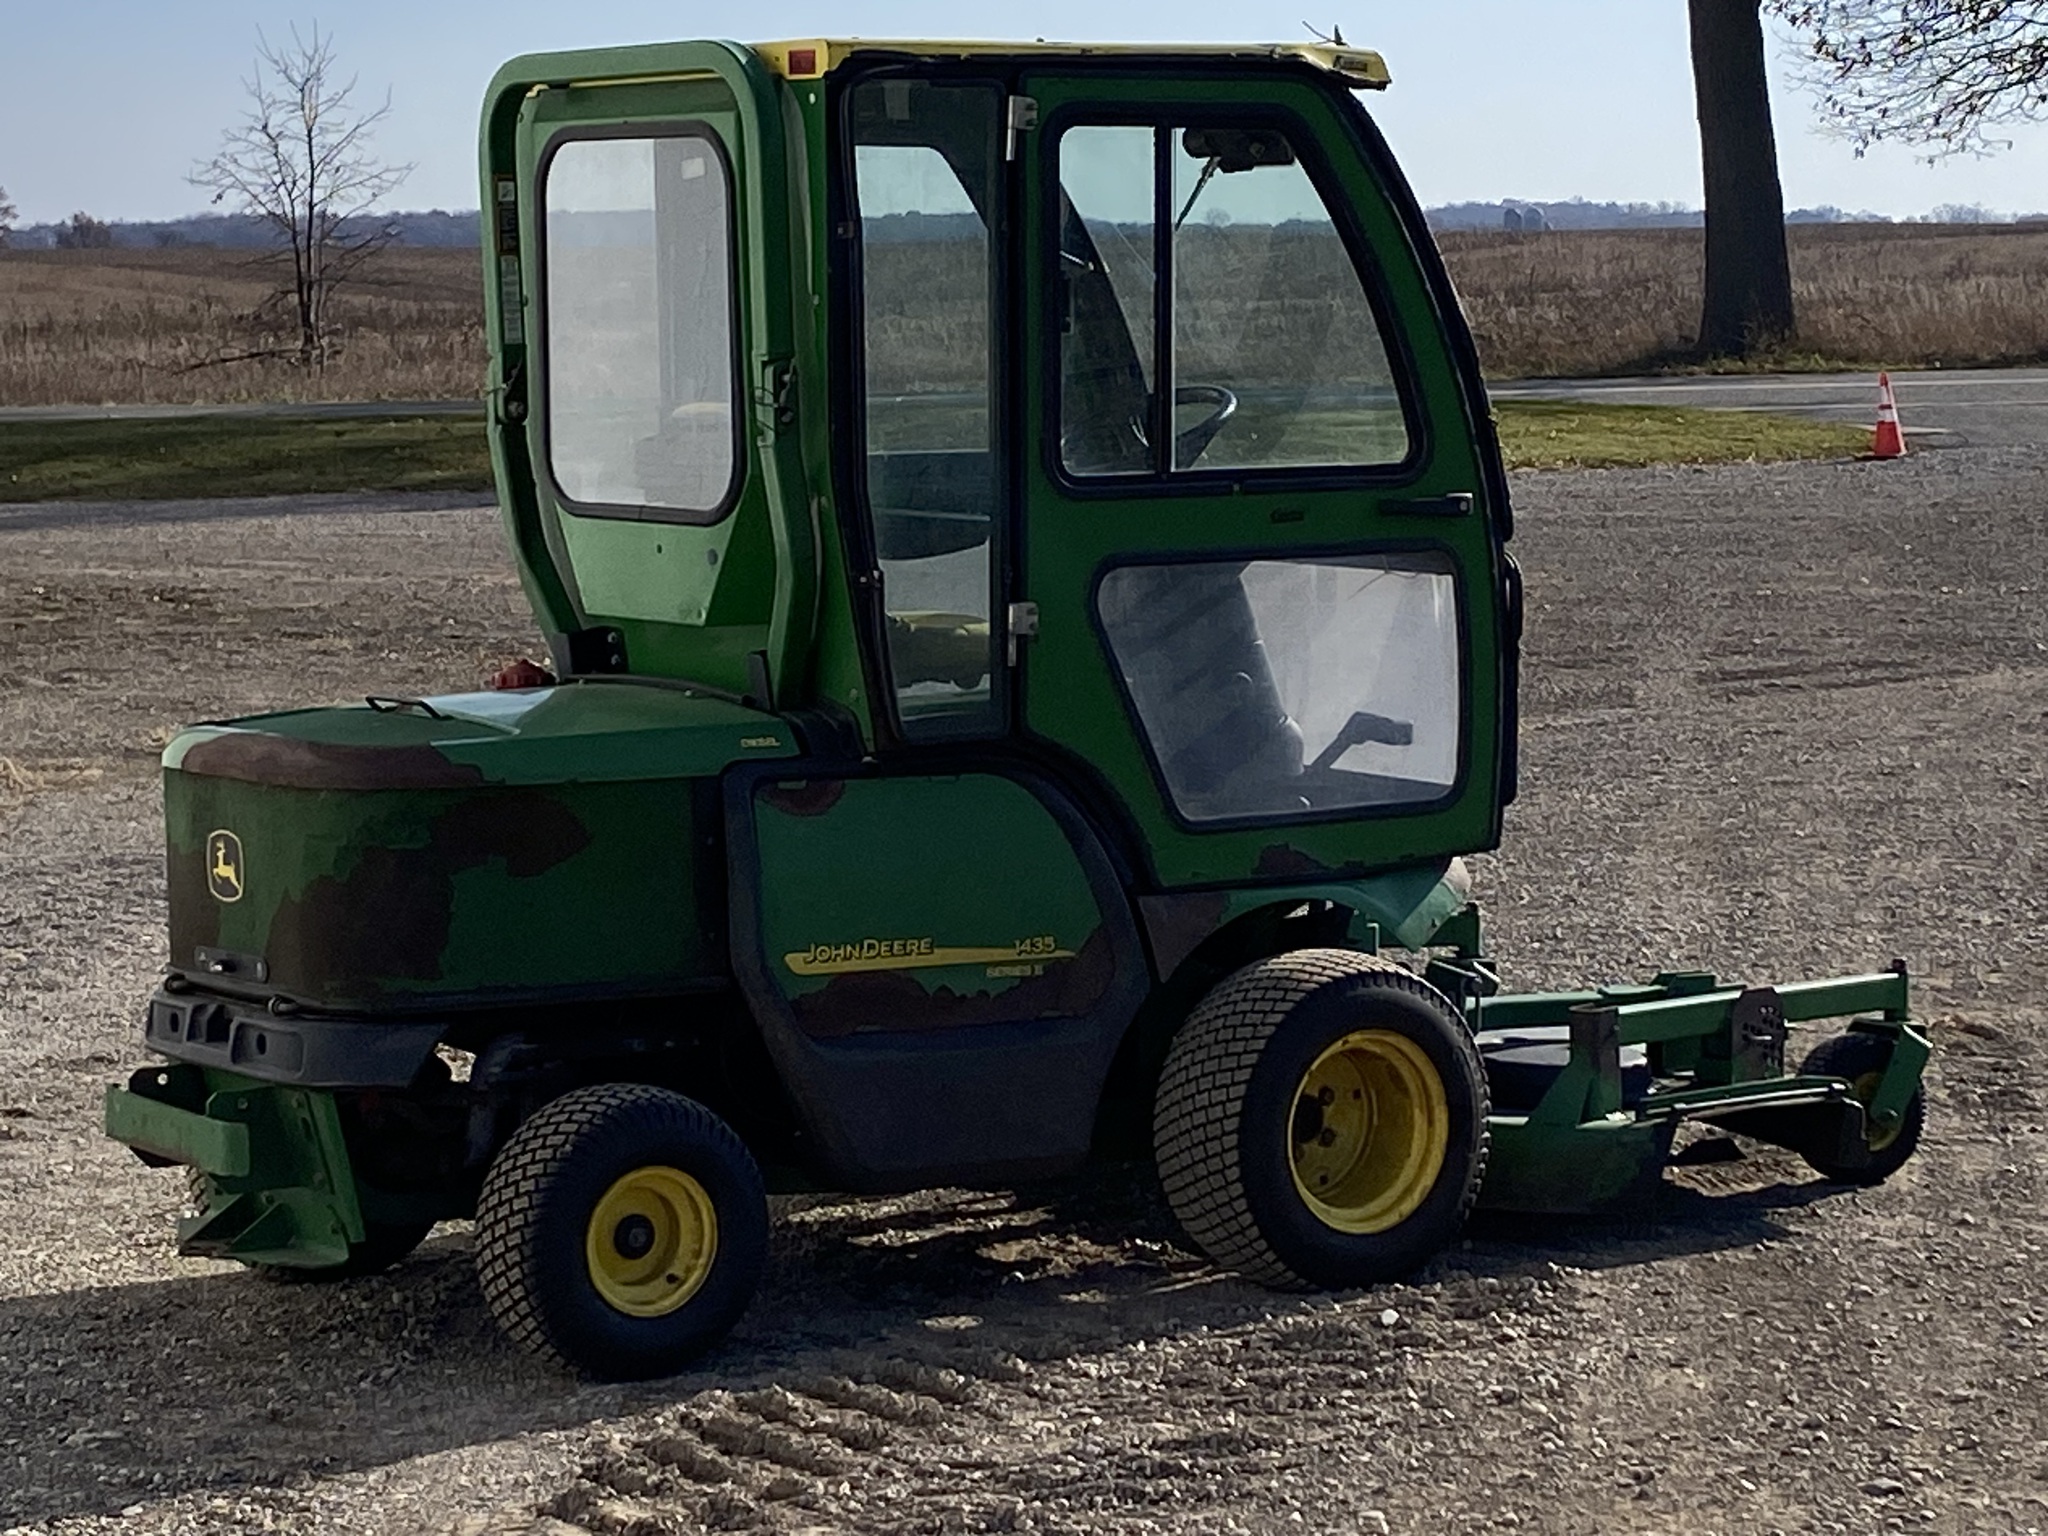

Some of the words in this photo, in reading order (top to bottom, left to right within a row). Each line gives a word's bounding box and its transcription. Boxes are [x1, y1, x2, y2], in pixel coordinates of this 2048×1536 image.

[804, 942, 860, 963] JOHN
[863, 938, 932, 958] DEERE
[1014, 936, 1056, 954] 1435
